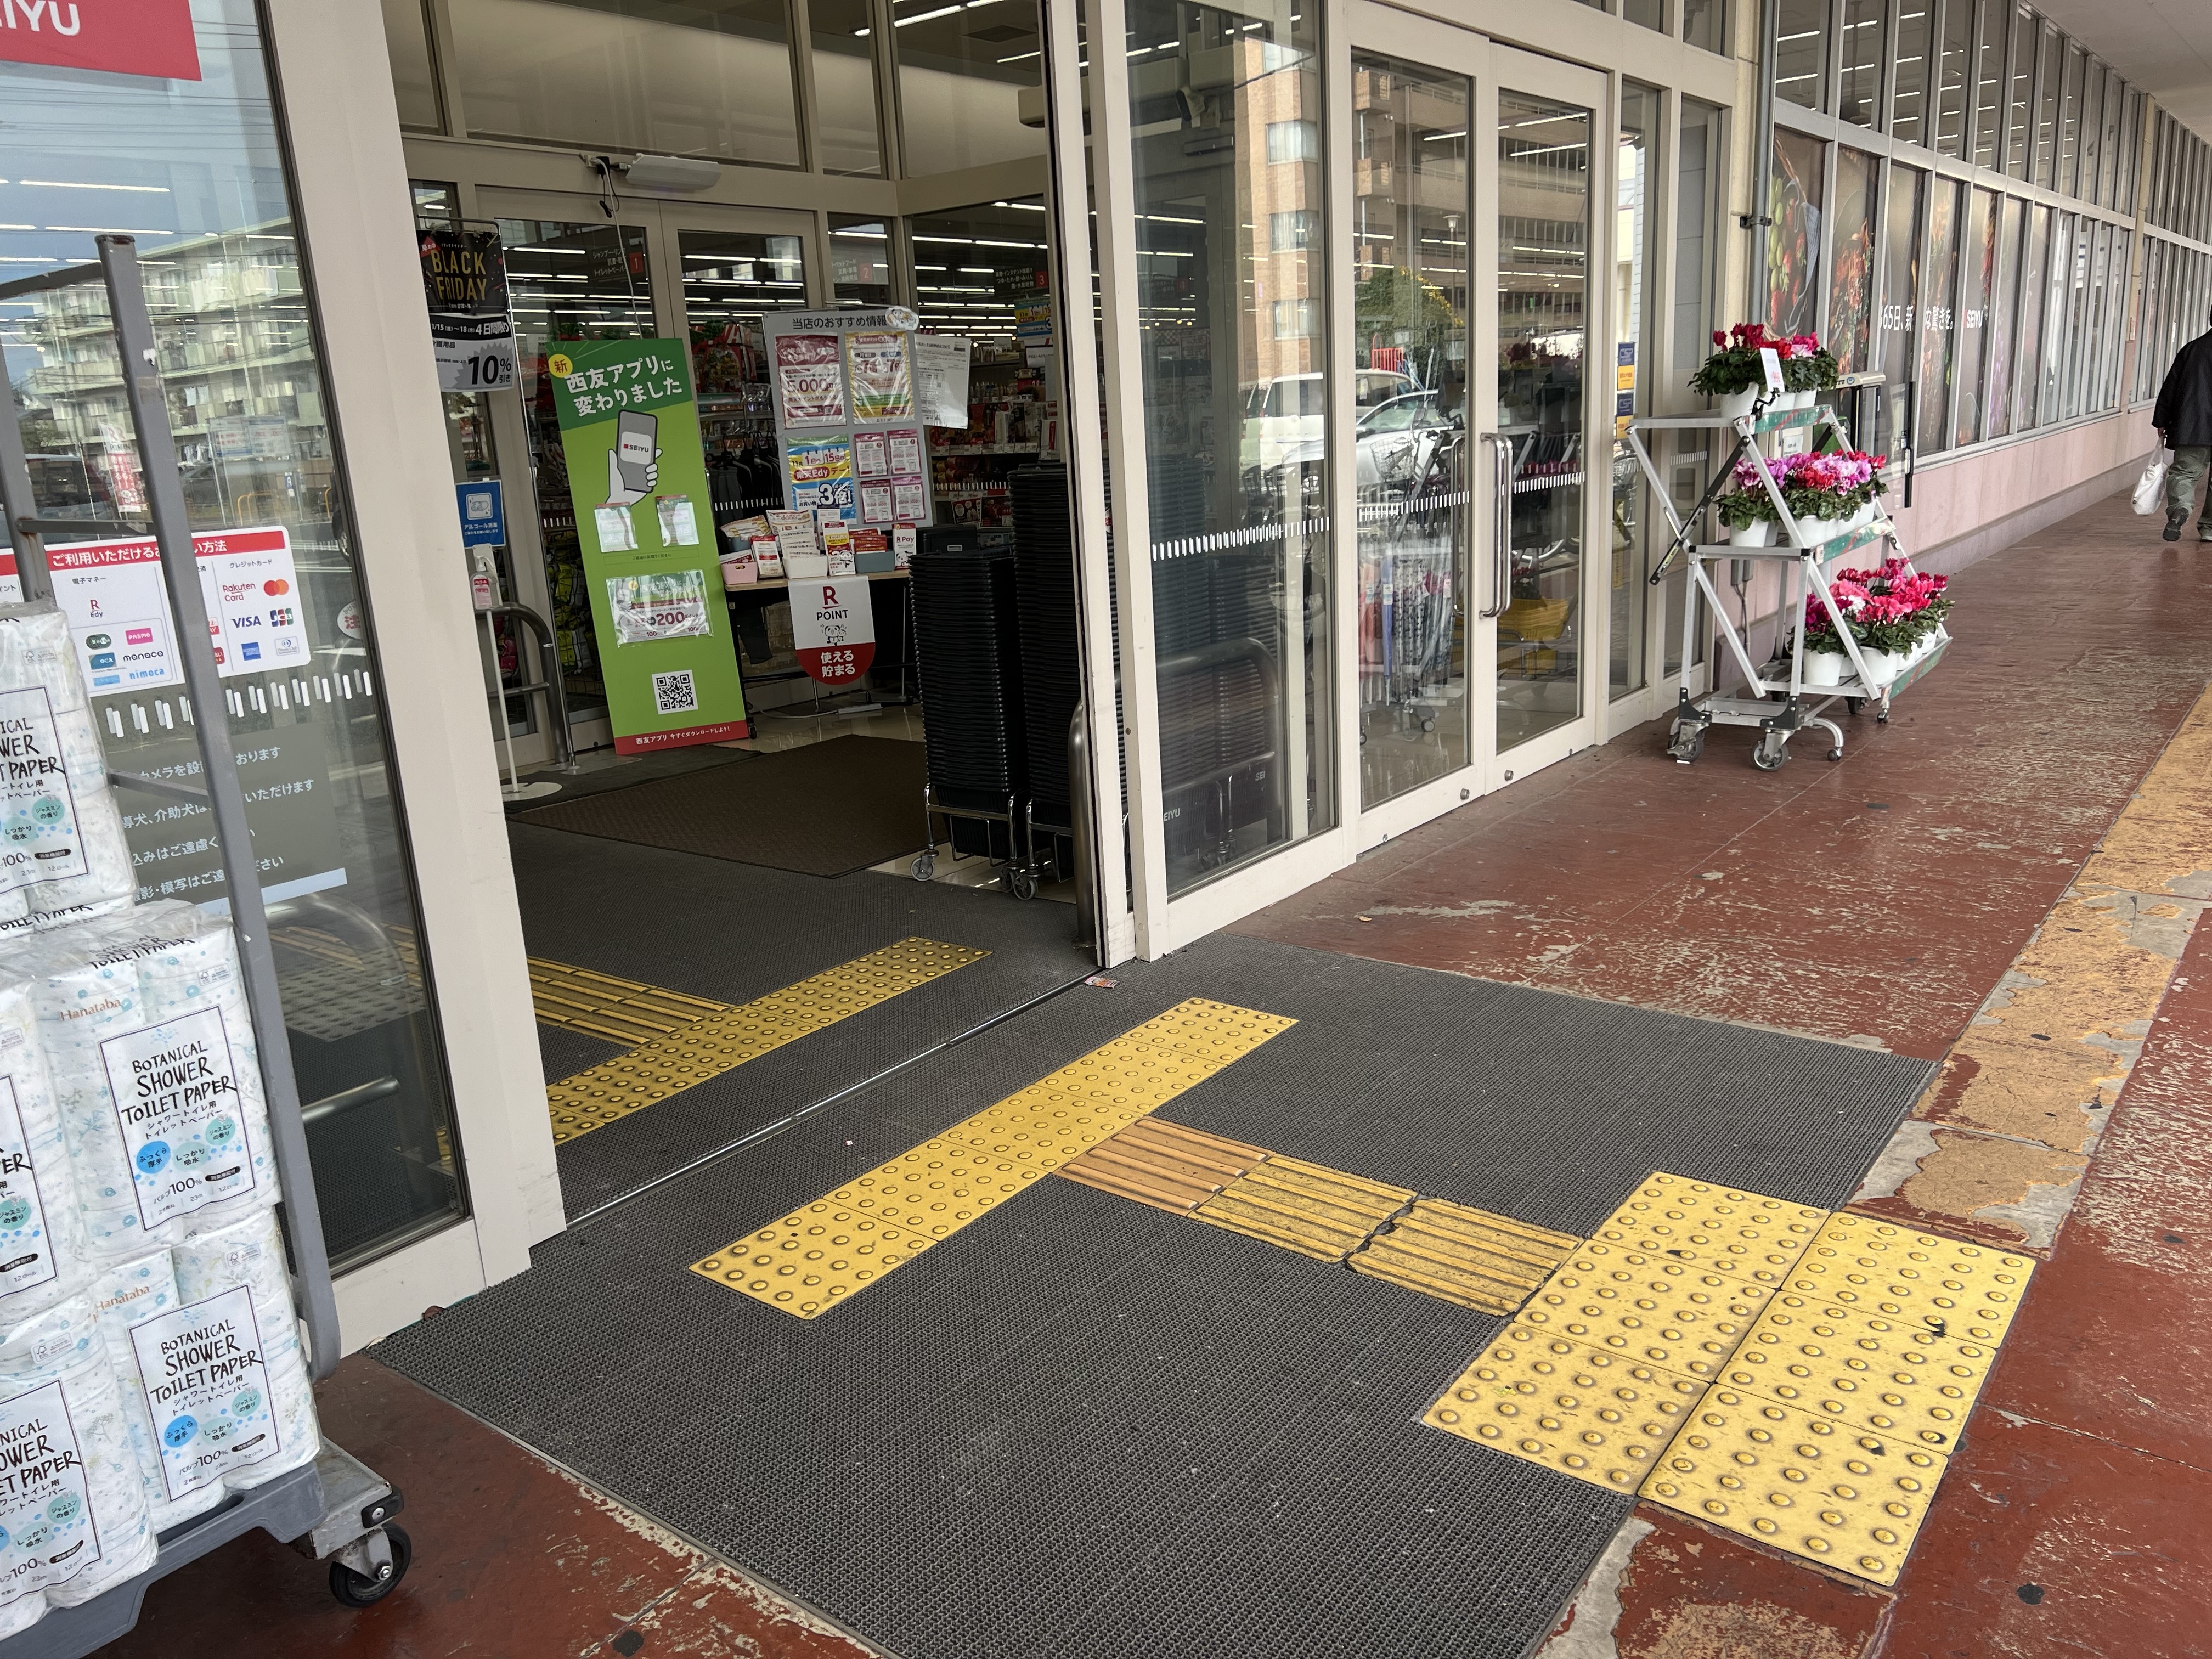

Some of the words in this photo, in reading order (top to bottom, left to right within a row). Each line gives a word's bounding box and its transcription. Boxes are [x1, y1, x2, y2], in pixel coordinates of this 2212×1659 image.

[430, 249, 487, 275] BLACK
[634, 257, 638, 269] 1
[864, 267, 869, 278] 2
[1040, 274, 1045, 285] 3
[436, 276, 487, 301] FRIDAY
[792, 314, 887, 330] 当店のおすすめ情報
[1966, 309, 1983, 328] SEIYU
[553, 359, 568, 373] 新
[499, 374, 511, 383] 引き
[563, 355, 674, 393] 西友アプリに
[573, 377, 682, 417] 変わりました
[629, 444, 649, 453] SEIYU
[229, 559, 273, 569] クレジットカード
[72, 576, 106, 585] 電子マネー
[222, 583, 256, 592] Rakuten
[224, 593, 244, 602] Card
[230, 616, 262, 628] VISA
[656, 611, 685, 626] 200
[816, 610, 849, 621] POINT
[123, 651, 164, 662] manaca
[820, 650, 854, 664] 使える
[129, 668, 165, 680] nimoca
[822, 663, 855, 678] 貯まる
[636, 734, 667, 745] 西友アプリ
[9, 757, 65, 781] PAPER
[139, 760, 204, 779] カメラを設
[236, 747, 280, 765] おります
[245, 779, 314, 803] いただけます
[35, 805, 61, 814] ジャスミン
[5, 826, 32, 836] しっかり
[59, 998, 121, 1021] Hanataba
[132, 1040, 208, 1074] BOTANICAL
[137, 1056, 214, 1098] SHOWER
[120, 1091, 180, 1125] TOILET
[184, 1075, 238, 1107] PAPER
[146, 1100, 217, 1130] シャワートイレ用
[145, 1109, 223, 1140] トイレットペーパー
[209, 1124, 232, 1136] ジャスミン
[213, 1131, 230, 1141] の香り
[139, 1147, 167, 1163] ふっくら
[176, 1148, 205, 1161] しっかり
[184, 1157, 200, 1166] 吸水
[148, 1158, 162, 1169] 厚手
[190, 1193, 204, 1202] 23m
[4, 1214, 24, 1224] の香り
[160, 1318, 236, 1355] BOTANICAL
[165, 1334, 241, 1376] SHOWER
[150, 1369, 206, 1404] TOILET
[210, 1350, 263, 1383] PAPER
[174, 1375, 243, 1406] シャワートイレ用
[172, 1383, 249, 1416] トイレットペーパー
[235, 1395, 258, 1408] ジャスミン
[239, 1401, 256, 1412] の香り
[166, 1421, 193, 1439] ふっくら
[174, 1430, 188, 1442] 厚手
[204, 1422, 232, 1436] しっかり
[212, 1431, 227, 1441] 吸水
[21, 1451, 82, 1489] PAPER
[179, 1461, 199, 1476] パルプ
[51, 1499, 77, 1514] ジャスミン
[17, 1527, 48, 1545] しっかり
